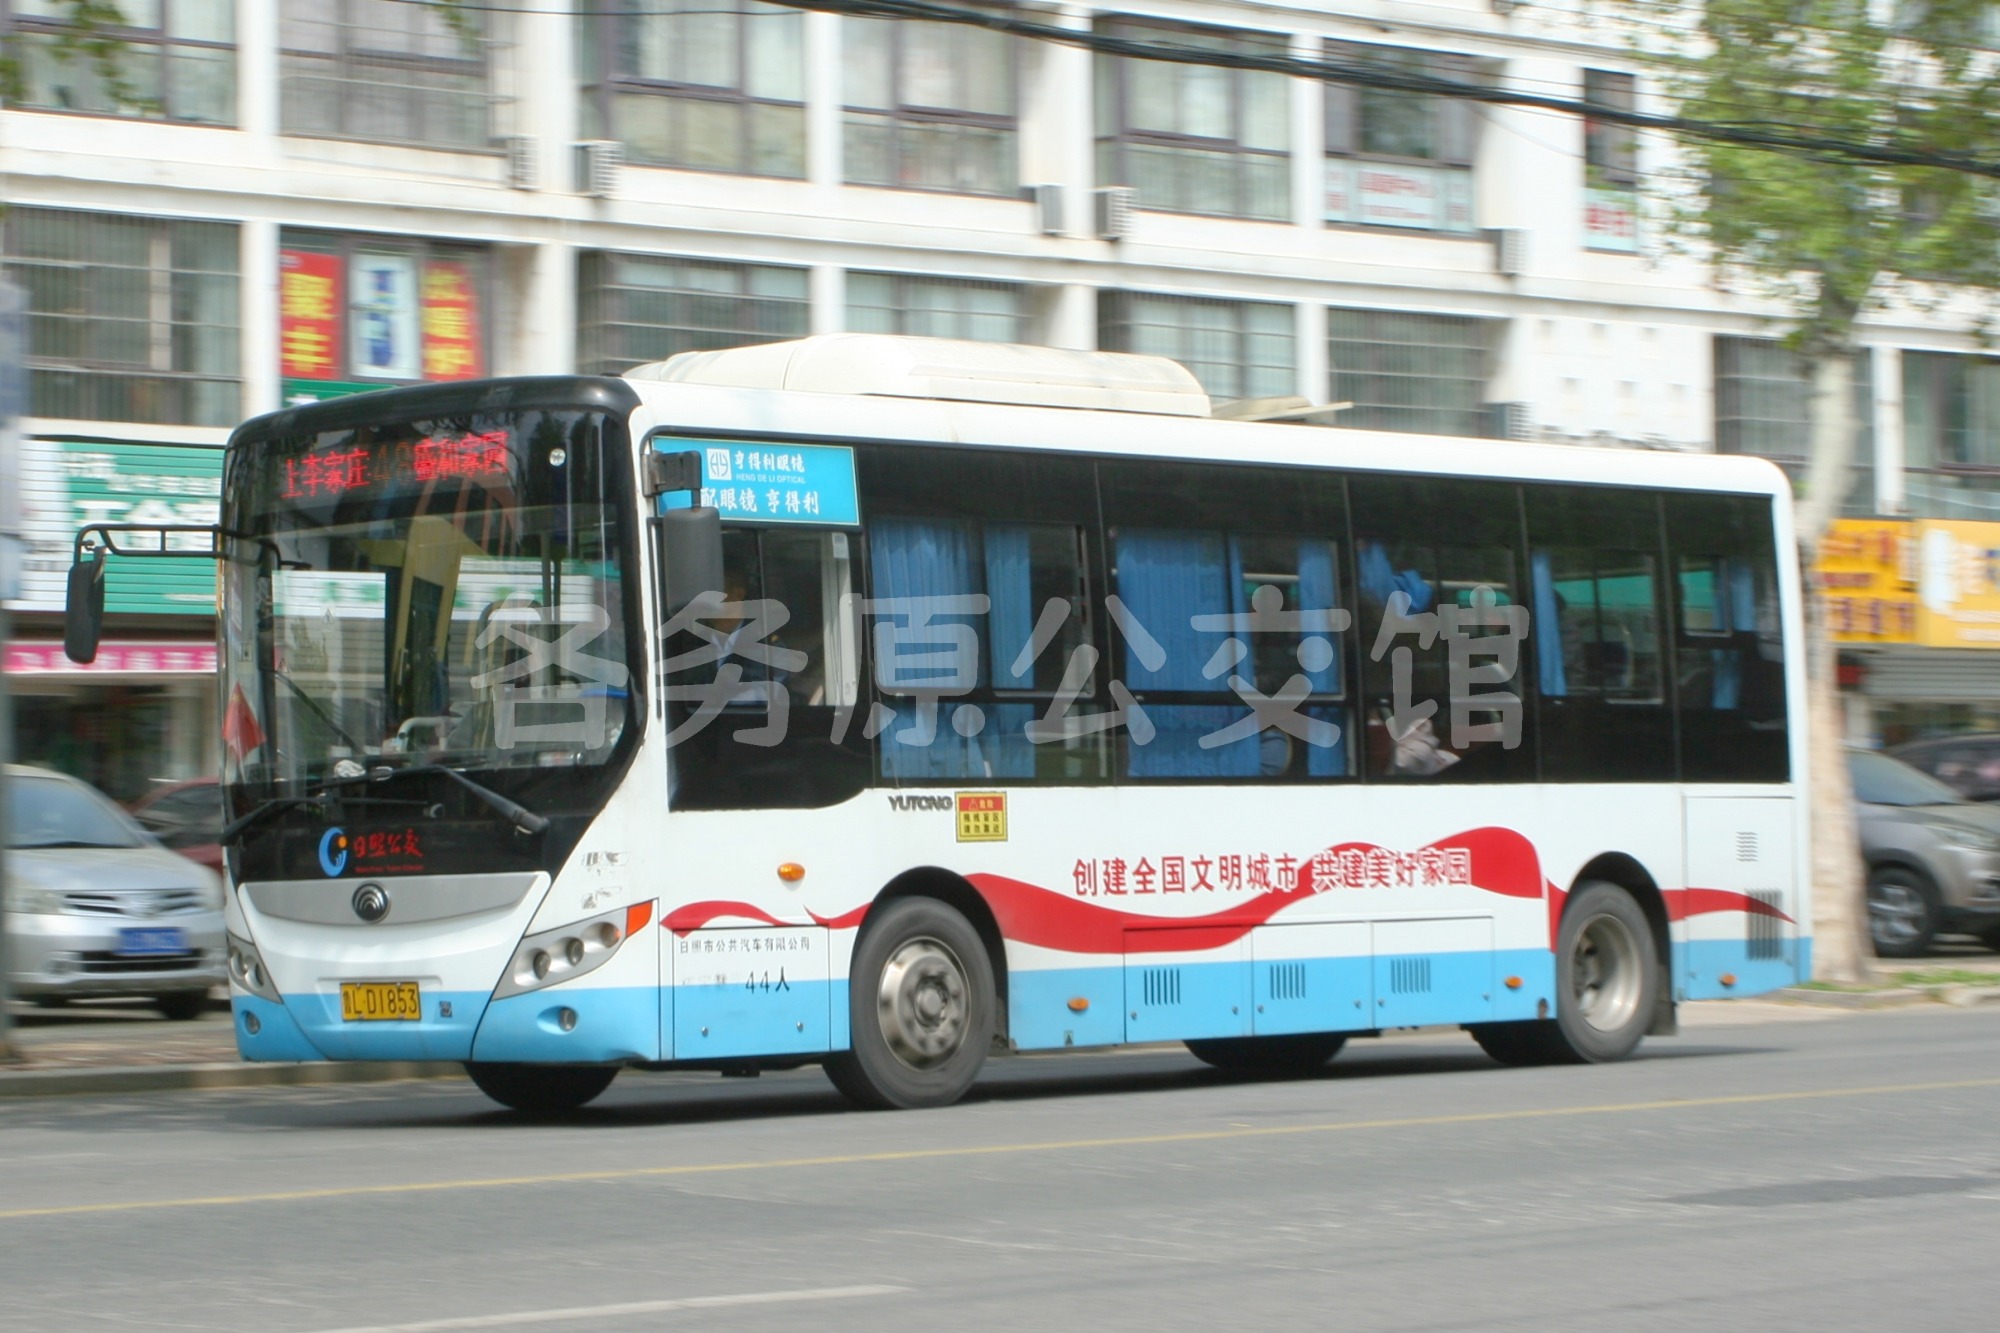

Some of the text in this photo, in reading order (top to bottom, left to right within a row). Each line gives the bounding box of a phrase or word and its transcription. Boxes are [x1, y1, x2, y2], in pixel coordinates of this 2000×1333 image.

[735, 450, 805, 473] 亨得利眼镜
[736, 473, 806, 484] HENG DE LI OPTICAL
[766, 489, 819, 515] 亨得利
[888, 795, 953, 812] YUTONG
[1072, 847, 1473, 897] 创建全国文明城市 共建美好家园
[680, 936, 810, 954] 日照市公共汽车有限公司
[745, 965, 791, 995] 44人
